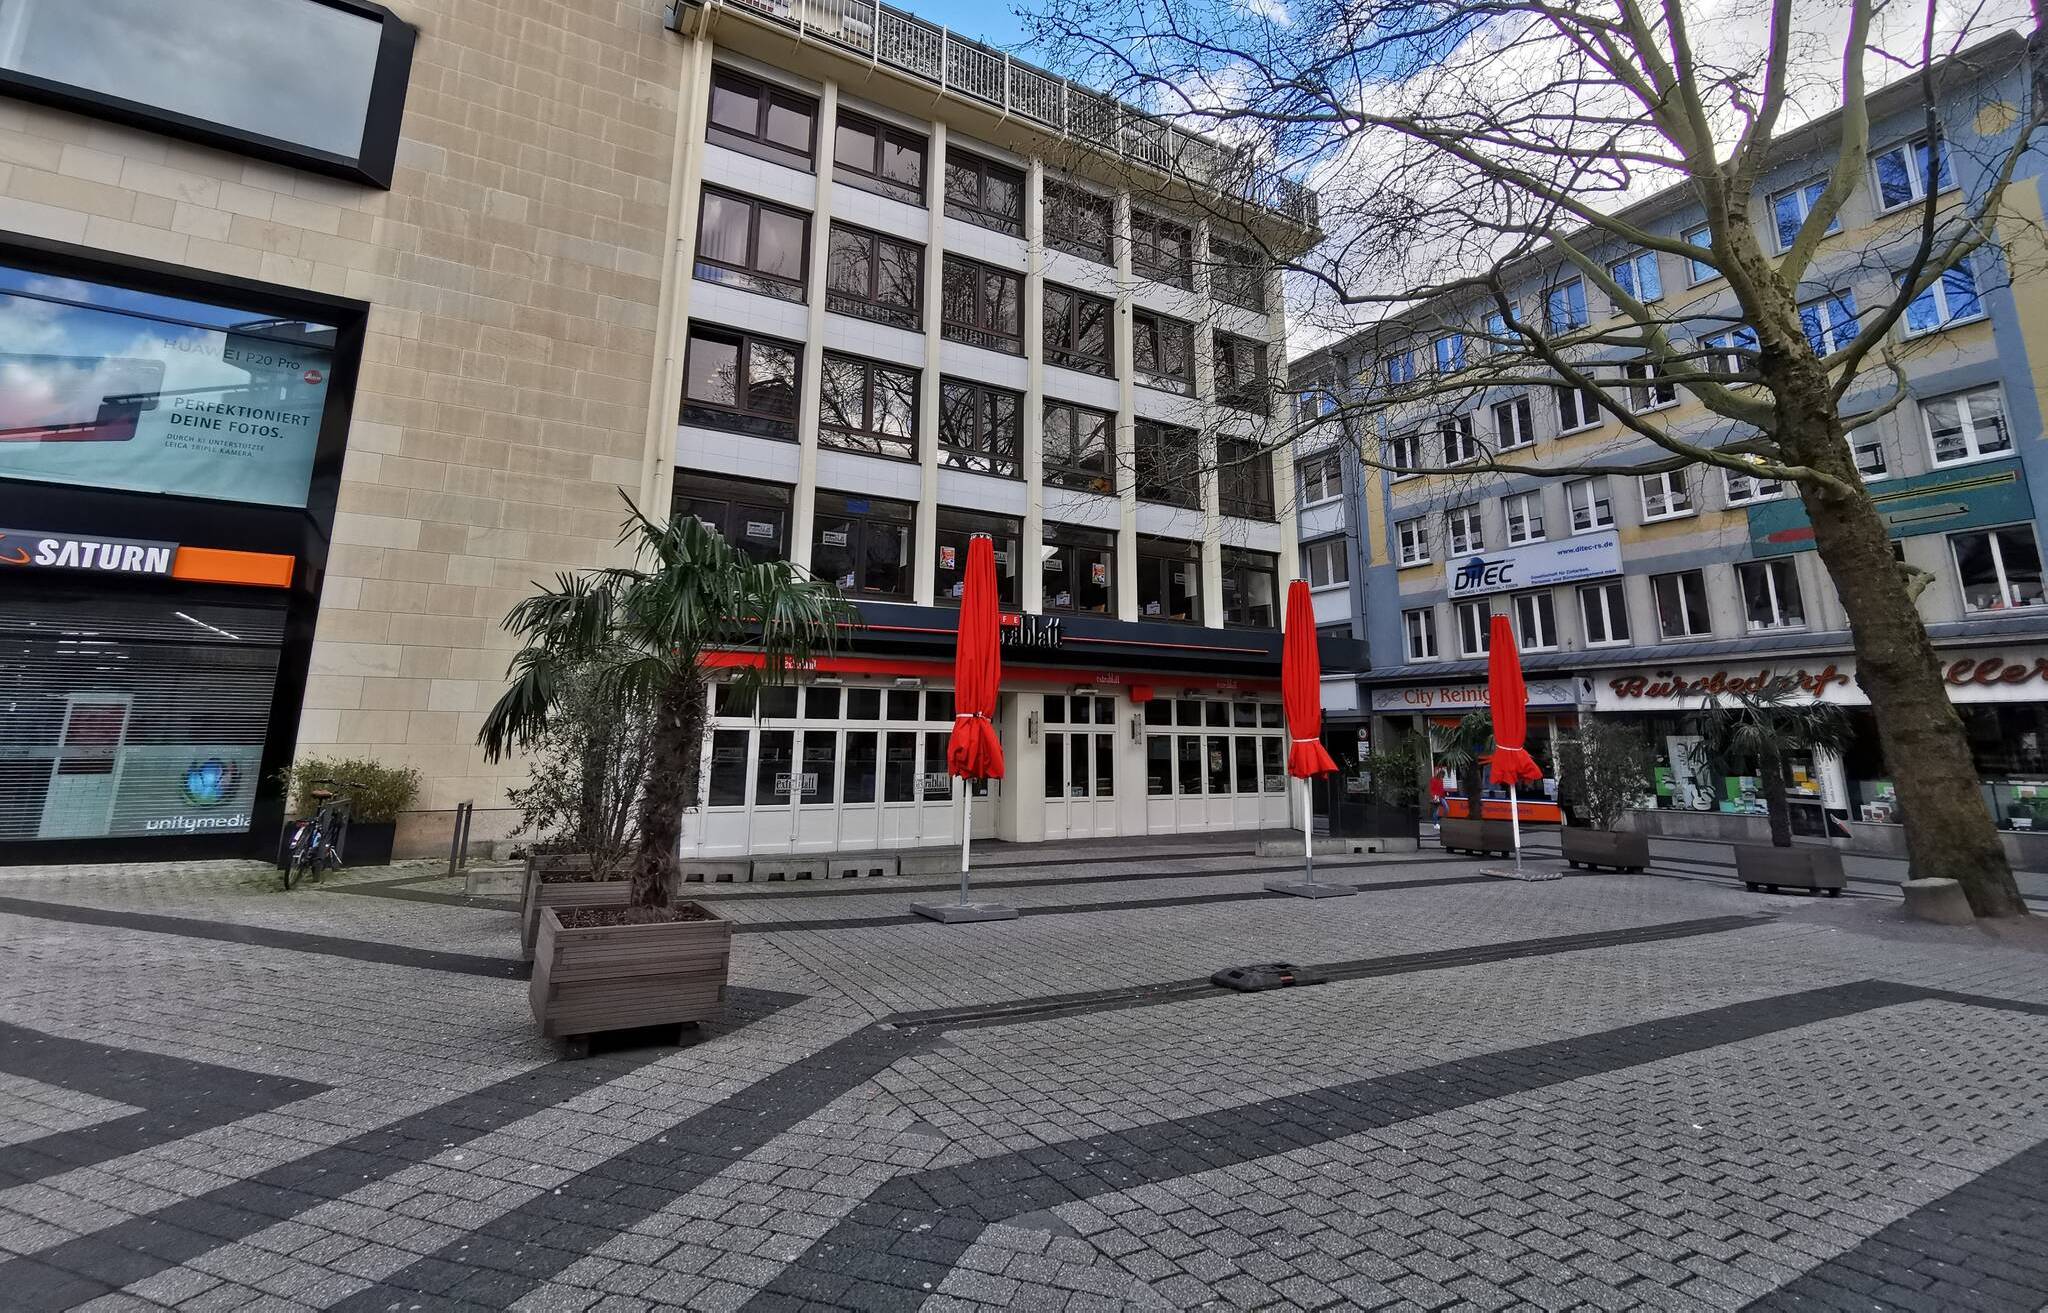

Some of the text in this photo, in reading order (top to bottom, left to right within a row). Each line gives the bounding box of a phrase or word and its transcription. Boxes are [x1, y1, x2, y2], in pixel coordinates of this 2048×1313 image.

[246, 352, 273, 367] P20
[278, 357, 301, 371] Pro
[174, 397, 311, 427] PERFEKTIONIERT
[170, 413, 285, 439] DEINE FOTOS.
[35, 539, 170, 574] SATURN
[1557, 541, 1614, 555] www.ditec-rs.de
[1404, 688, 1434, 707] City
